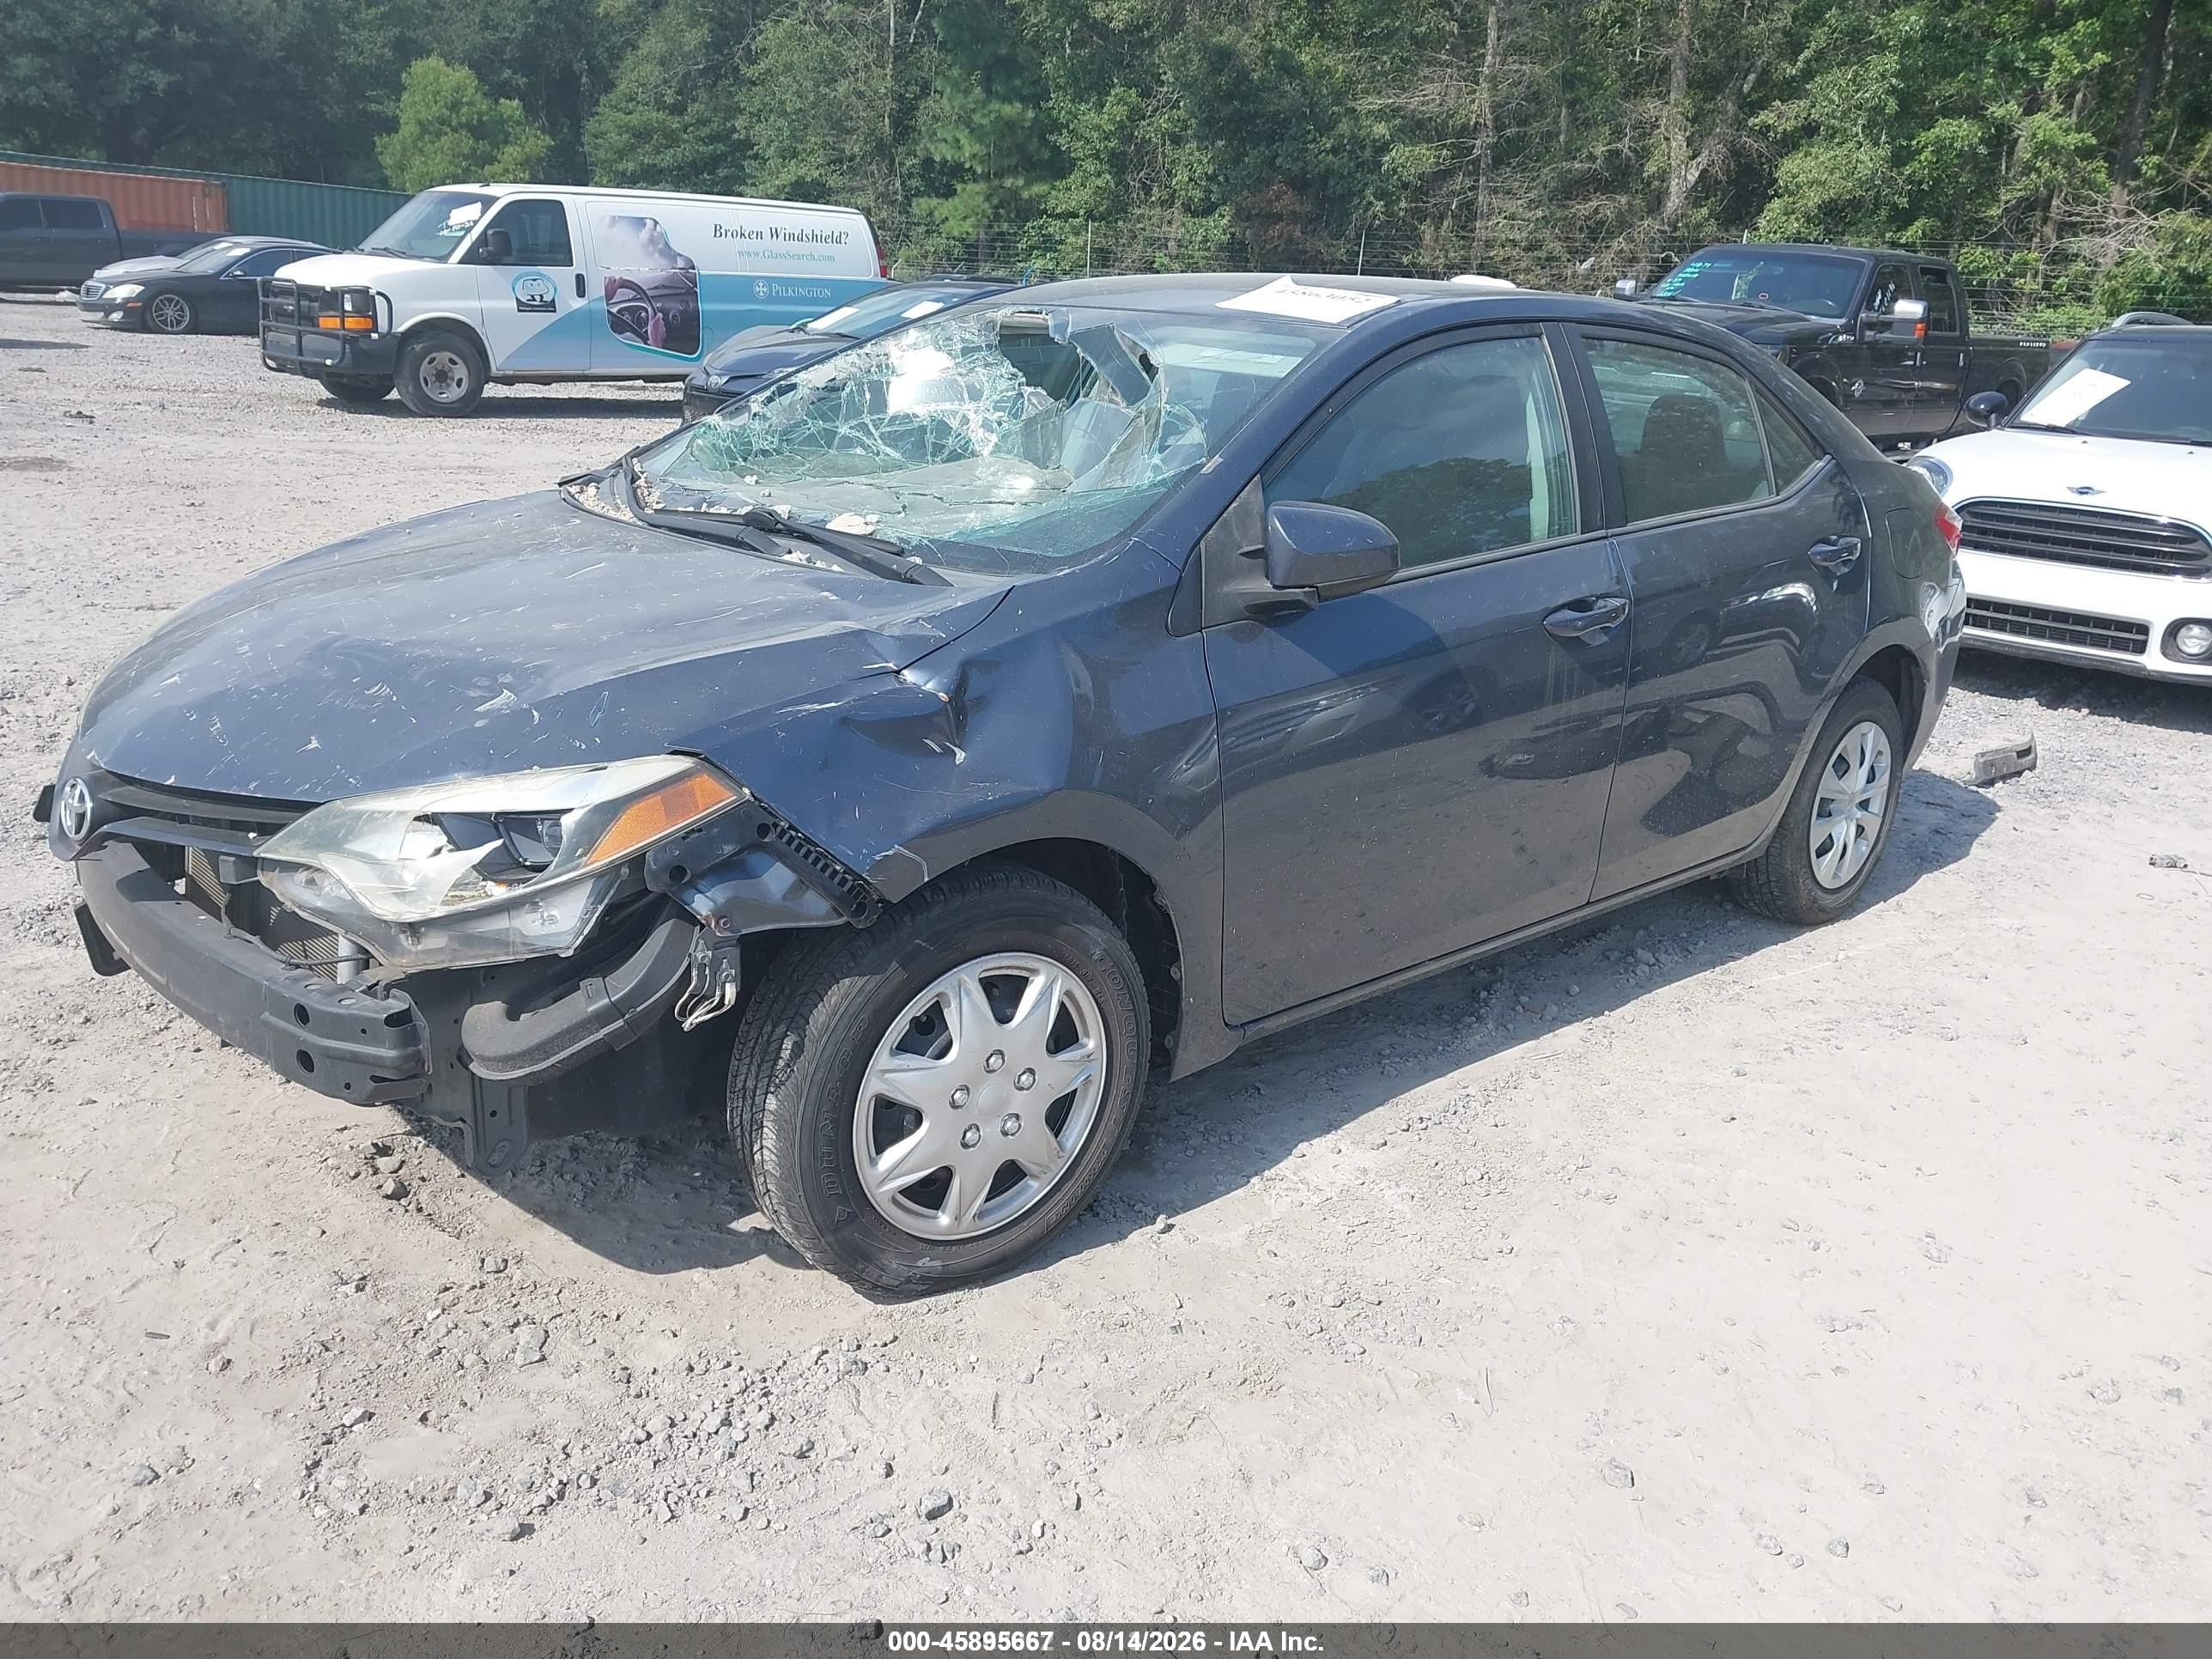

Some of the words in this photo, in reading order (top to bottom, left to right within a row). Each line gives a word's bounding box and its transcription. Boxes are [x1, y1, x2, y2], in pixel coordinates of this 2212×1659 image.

[713, 223, 763, 240] Broken
[769, 226, 850, 246] Windshield?
[738, 250, 836, 263] www.GlassSearch.com
[772, 283, 831, 298] PILKINGTON
[818, 1015, 869, 1197] DUNLOP
